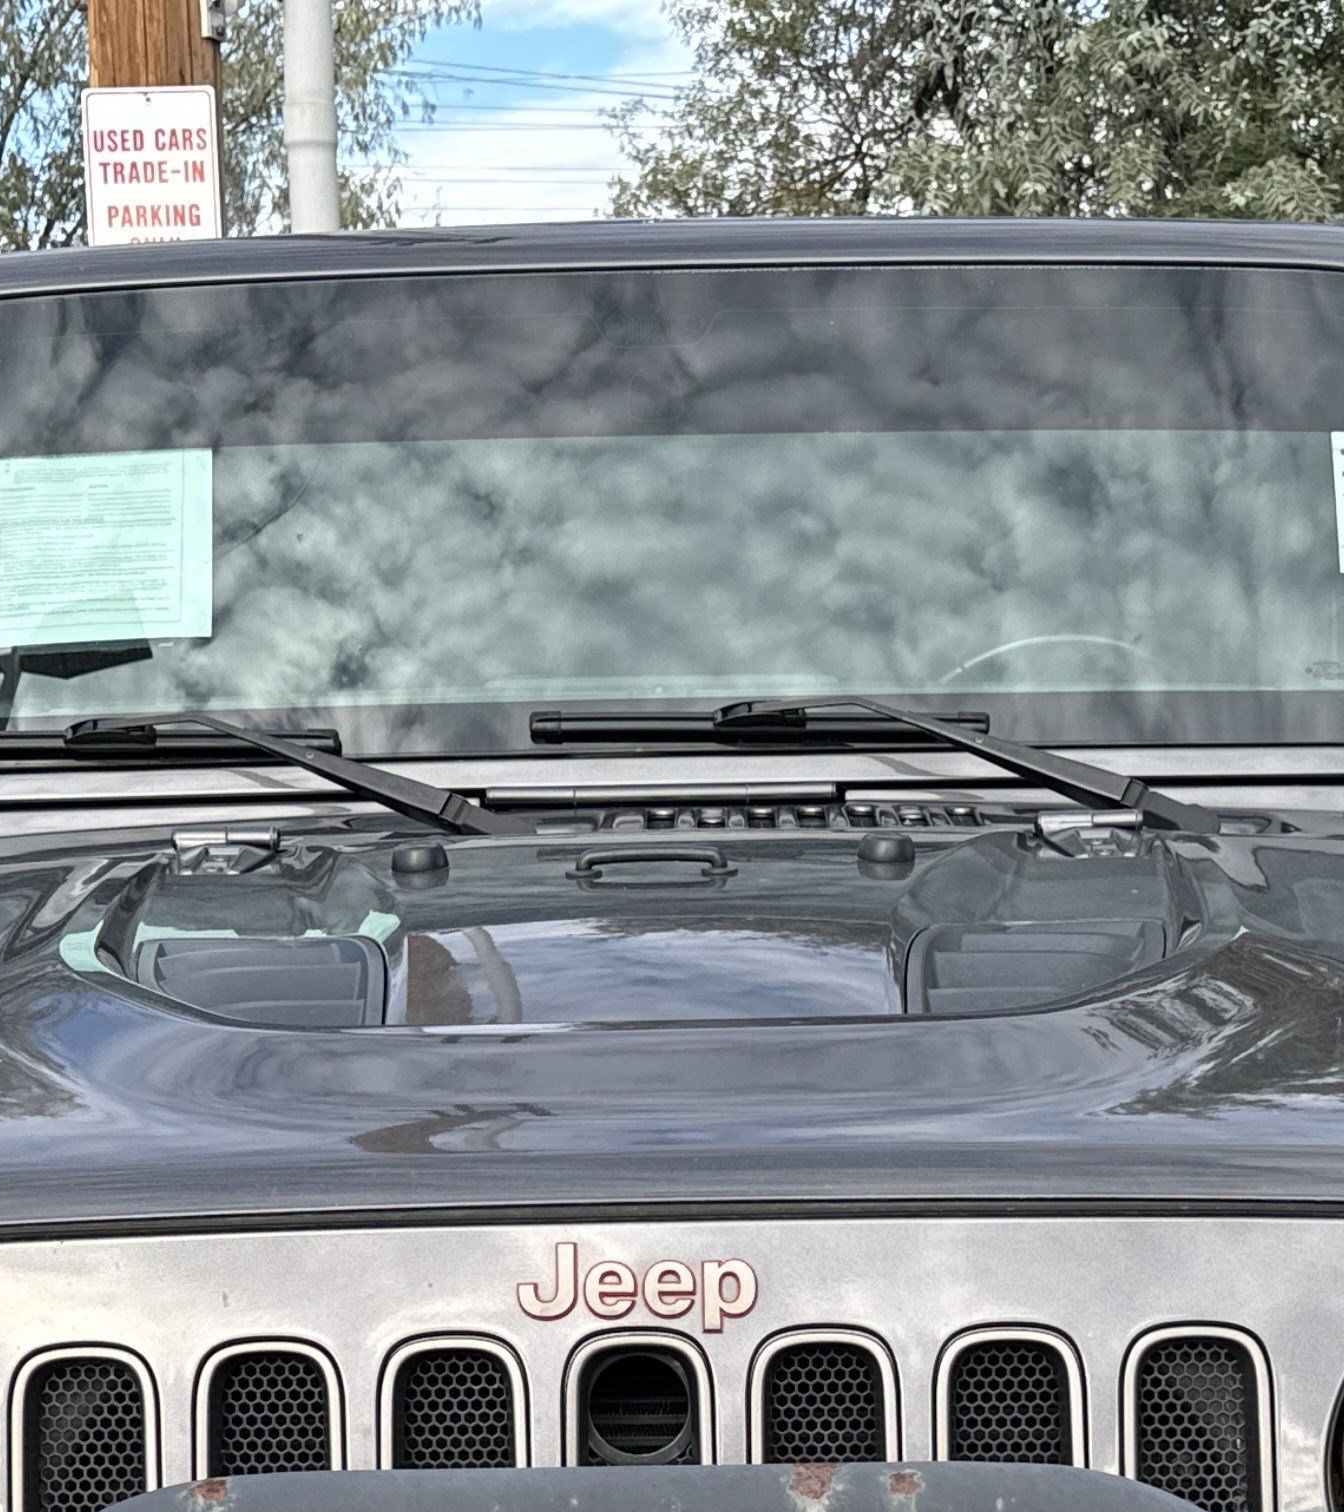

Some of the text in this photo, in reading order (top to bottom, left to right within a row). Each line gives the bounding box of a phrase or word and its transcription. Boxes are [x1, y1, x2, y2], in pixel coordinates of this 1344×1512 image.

[92, 128, 208, 153] USED CARS
[98, 160, 206, 185] TRADE-IN
[107, 203, 202, 229] PARKING
[516, 1241, 757, 1335] Jeep
